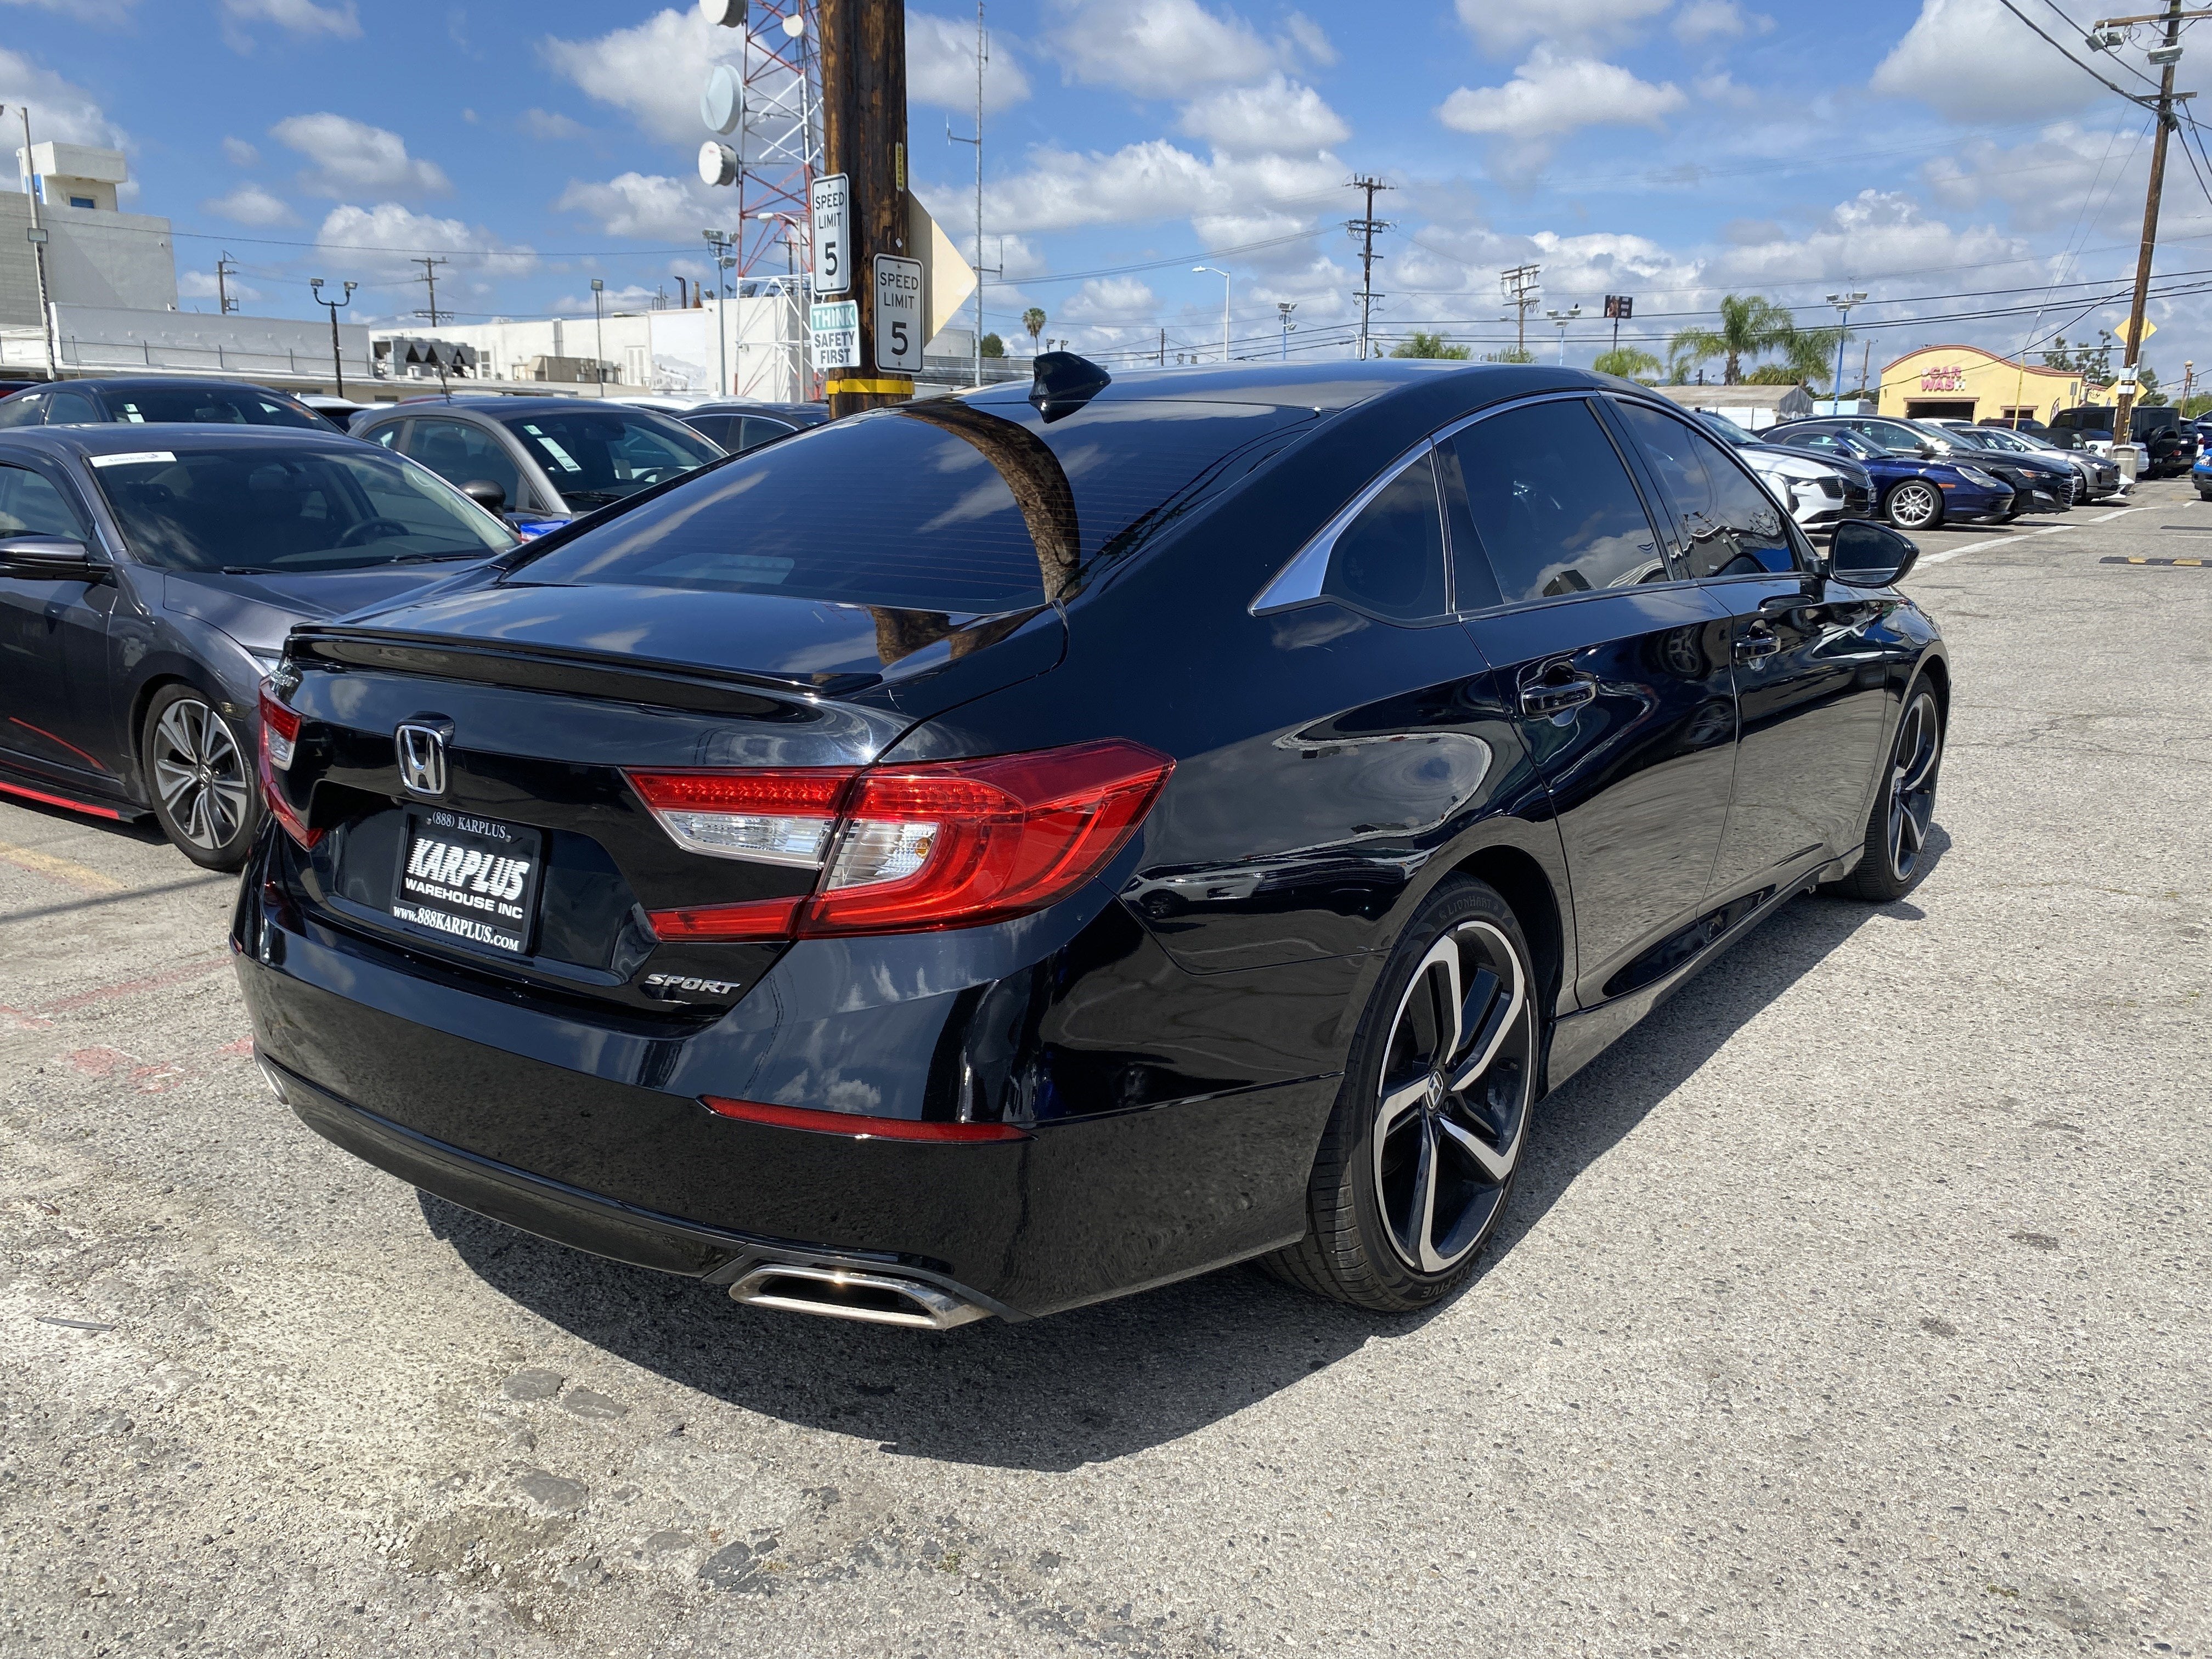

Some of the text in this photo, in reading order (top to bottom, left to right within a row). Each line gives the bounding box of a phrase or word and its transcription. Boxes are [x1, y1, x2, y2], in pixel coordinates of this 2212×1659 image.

[815, 191, 845, 210] SPEED
[819, 211, 842, 229] LIMIT
[825, 241, 838, 276] 5
[880, 272, 918, 290] SPEED
[884, 292, 915, 309] LIMIT
[812, 307, 855, 328] THINK
[815, 331, 855, 348] SAFETY
[891, 321, 908, 355] 5
[821, 348, 850, 364] FIRST
[1929, 366, 1962, 379] CAR
[1921, 379, 1966, 392] WASH
[432, 811, 506, 838] (888) KARPLUS
[406, 838, 531, 900] KARPLUS
[405, 878, 523, 919] WAREHOUSE INC
[1447, 895, 1492, 916] LIONHART
[645, 973, 741, 995] SPORT
